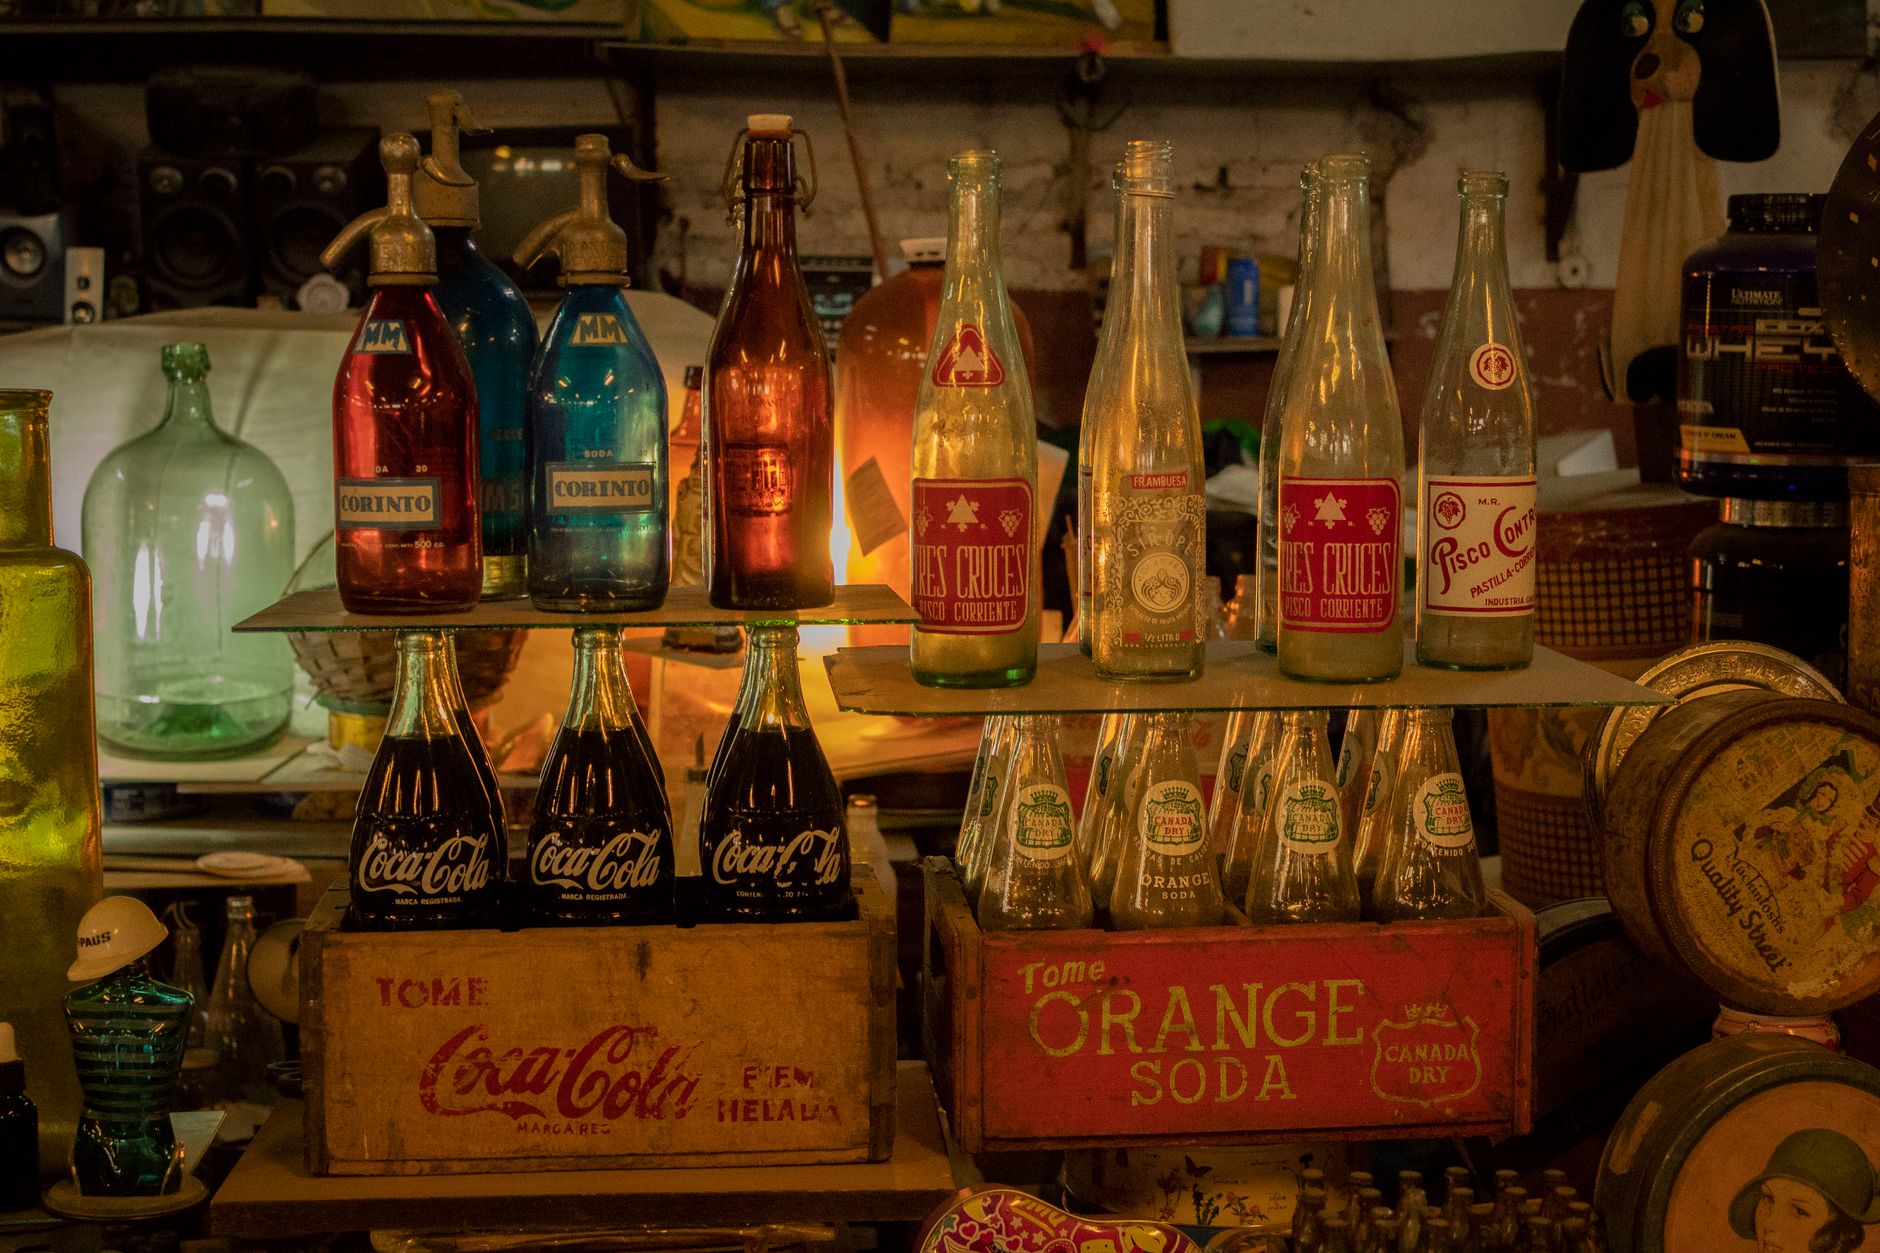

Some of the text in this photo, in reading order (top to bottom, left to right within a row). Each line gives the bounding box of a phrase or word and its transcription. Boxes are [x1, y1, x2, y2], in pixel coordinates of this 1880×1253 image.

[578, 316, 621, 343] MM
[1687, 335, 1838, 361] WHEY
[555, 479, 650, 497] CORINTO
[1134, 476, 1186, 487] FRAMBUESA
[342, 495, 431, 512] CORINTO
[1494, 506, 1535, 558] CONTR
[414, 540, 431, 549] 500
[914, 544, 1025, 598] TRES CRUCES
[1281, 541, 1391, 595] TRES CRUCES
[1285, 597, 1383, 618] PISCO CORRIENTE
[1485, 597, 1524, 606] INDUSTRIA
[954, 601, 1017, 621] CORRIENTE
[1157, 632, 1180, 642] LITRO
[1024, 818, 1063, 828] CANADA
[1155, 815, 1193, 825] CANADA
[1293, 813, 1330, 822] CANADA
[1035, 829, 1054, 837] DRY
[1165, 826, 1184, 835] DRY
[1302, 824, 1321, 832] DRY
[359, 831, 489, 894] Coca-Cola
[531, 828, 661, 891] Coca-Cola
[1170, 857, 1182, 866] DE
[1142, 872, 1210, 889] ORANGE
[1162, 891, 1196, 900] SODA
[1691, 838, 1788, 973] Quality Street
[1018, 959, 1105, 994] Tome
[375, 976, 489, 1008] TOME
[1029, 979, 1365, 1057] ORANGE
[1385, 1044, 1470, 1062] CANADA
[419, 1023, 704, 1121] Coca-Cola
[1130, 1054, 1297, 1106] SODA
[1409, 1066, 1450, 1084] DRY
